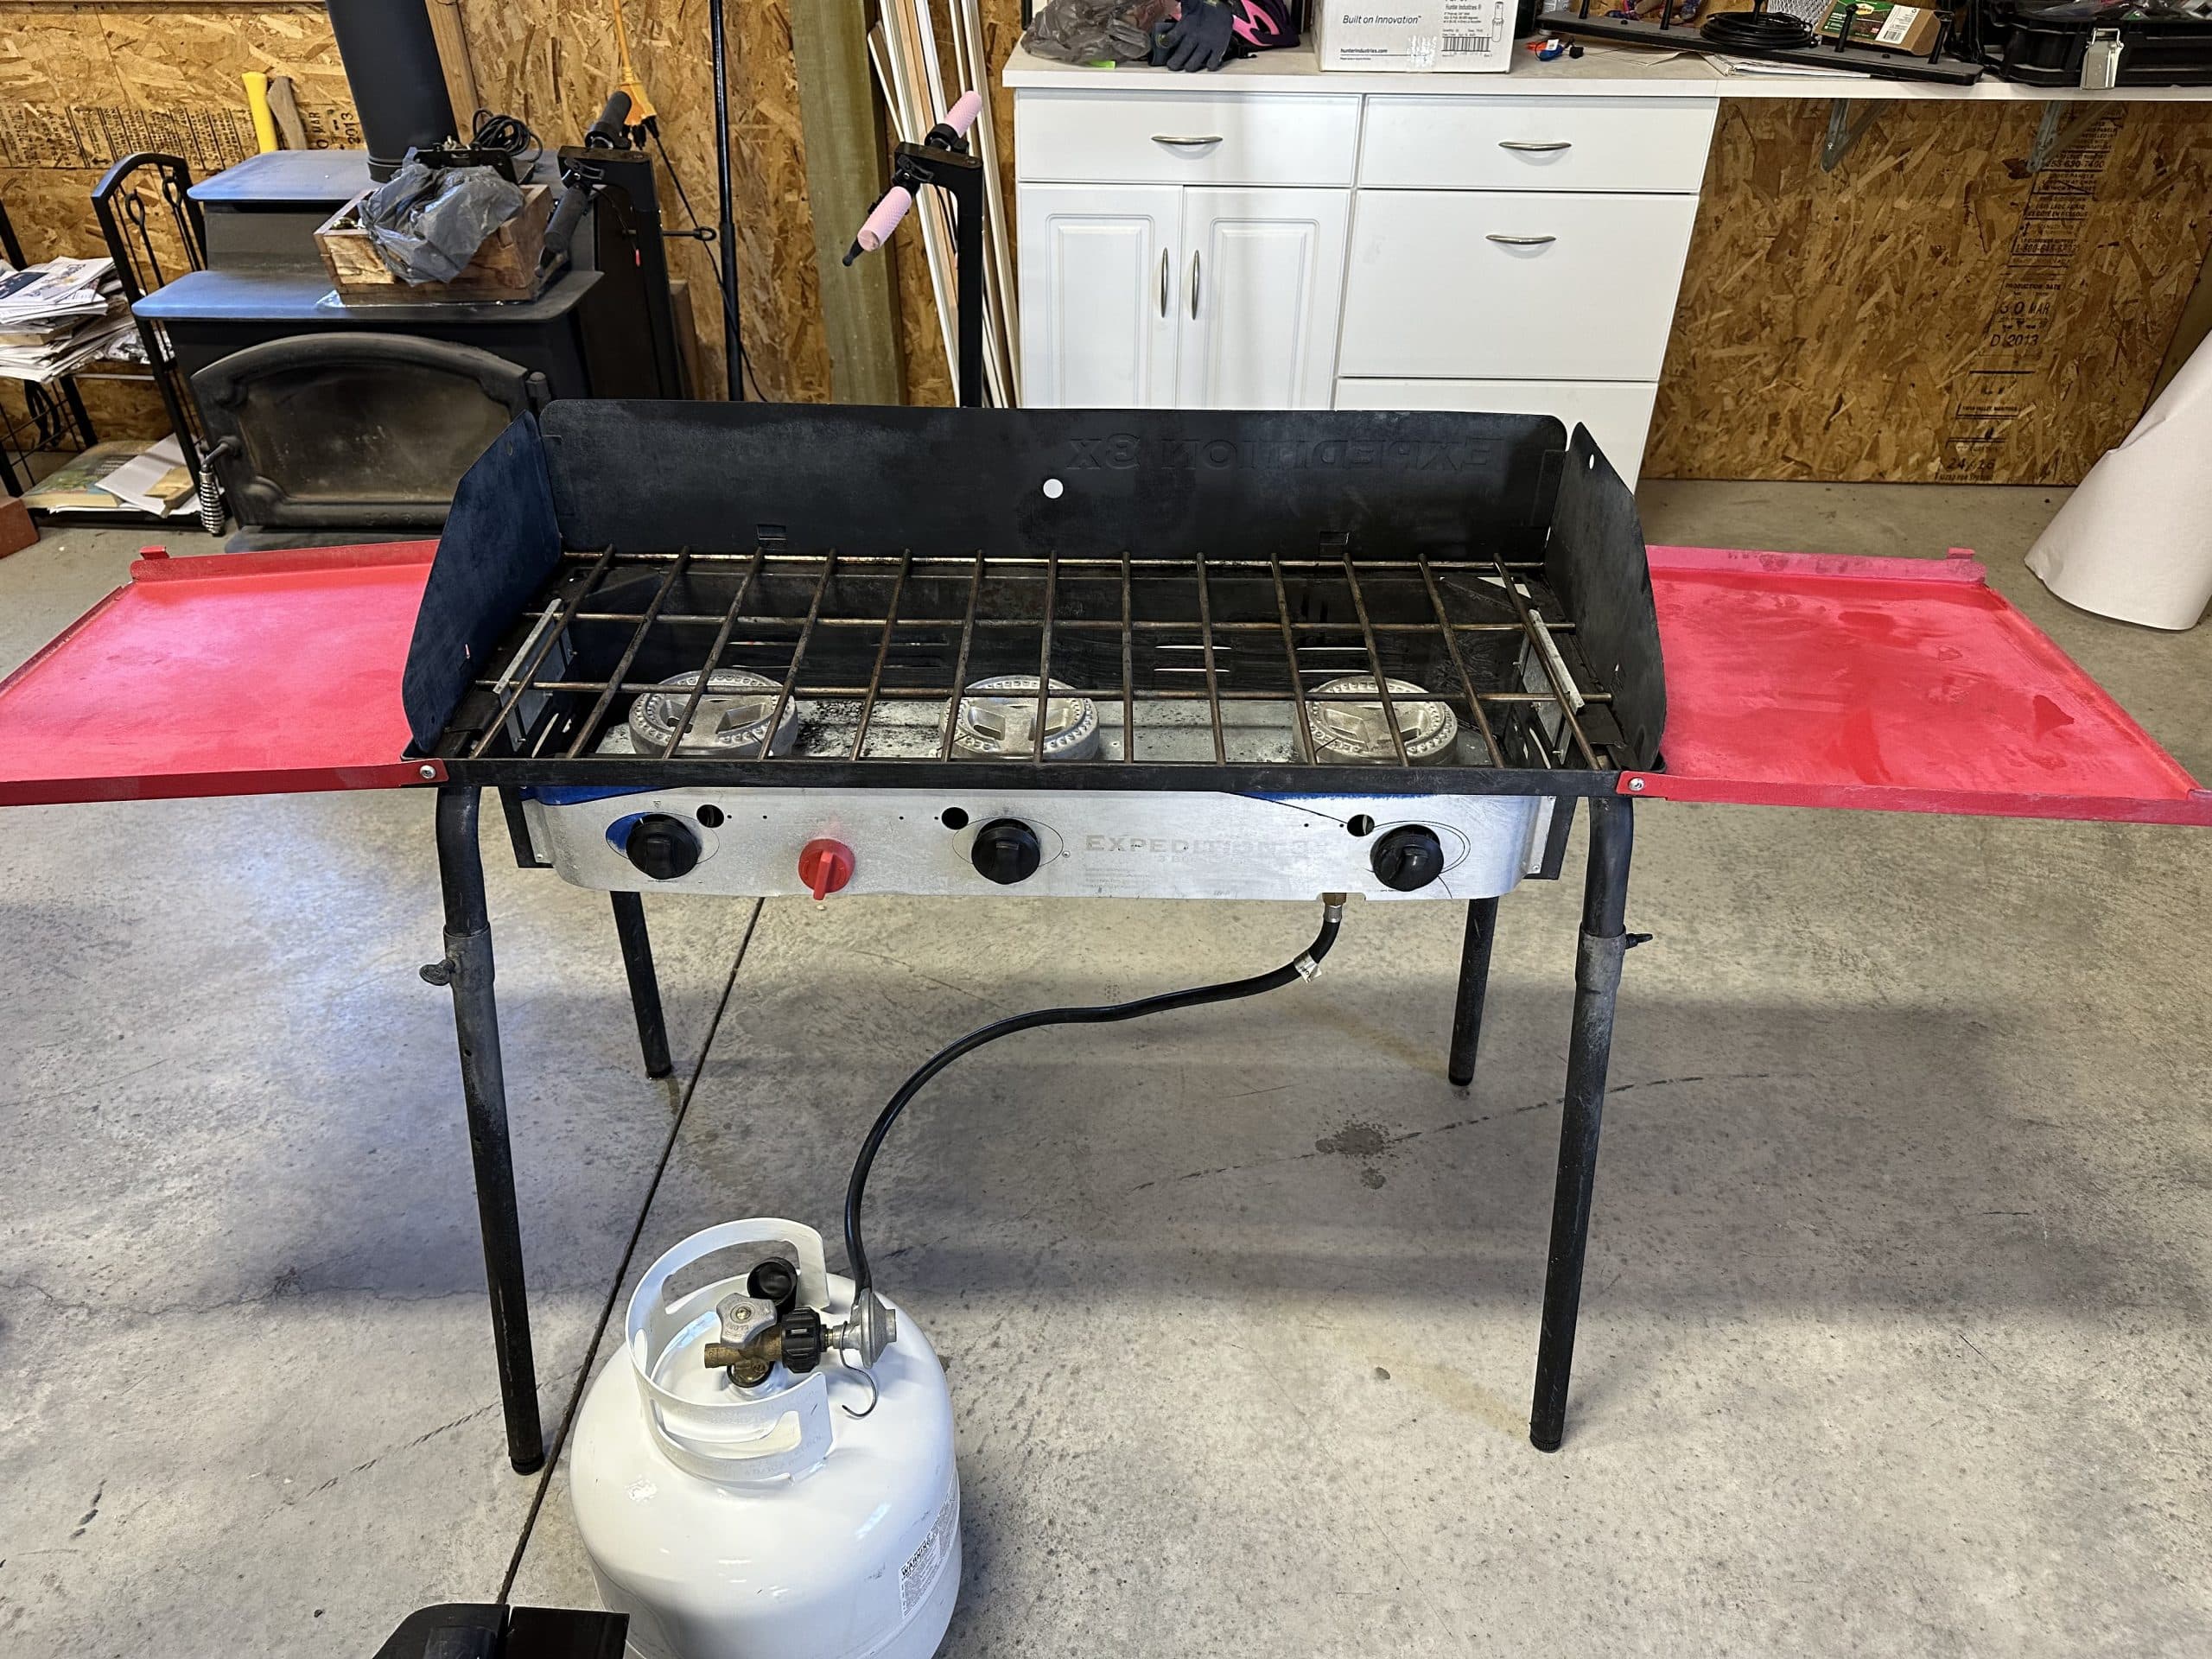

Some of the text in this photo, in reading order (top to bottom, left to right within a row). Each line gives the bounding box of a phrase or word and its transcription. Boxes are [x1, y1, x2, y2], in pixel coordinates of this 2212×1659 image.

[1343, 15, 1362, 24] Built
[309, 112, 326, 133] MAR
[340, 112, 361, 144] 2013
[2028, 302, 2050, 315] MAR
[2005, 334, 2038, 346] 2013
